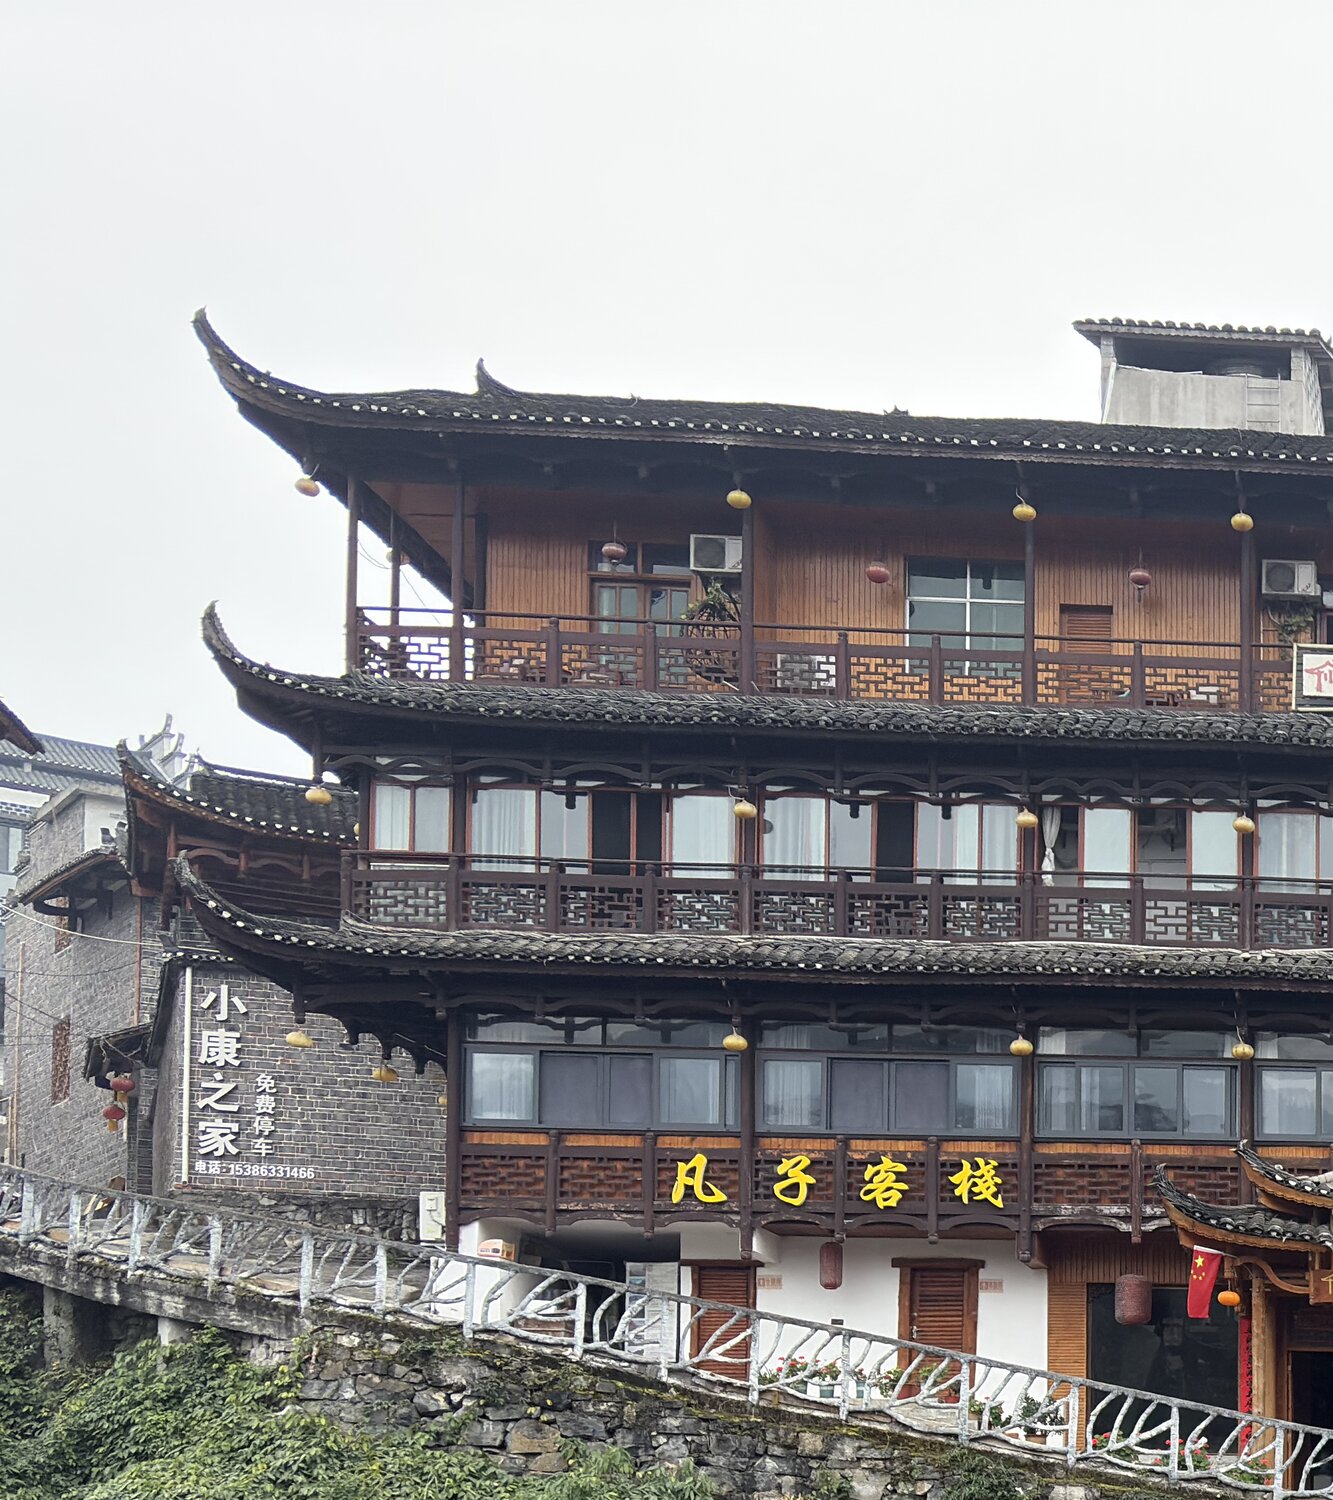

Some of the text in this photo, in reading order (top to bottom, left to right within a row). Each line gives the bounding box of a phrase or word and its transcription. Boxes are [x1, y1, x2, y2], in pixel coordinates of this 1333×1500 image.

[196, 984, 248, 1157] 小康之家
[251, 1073, 278, 1157] 免费停车
